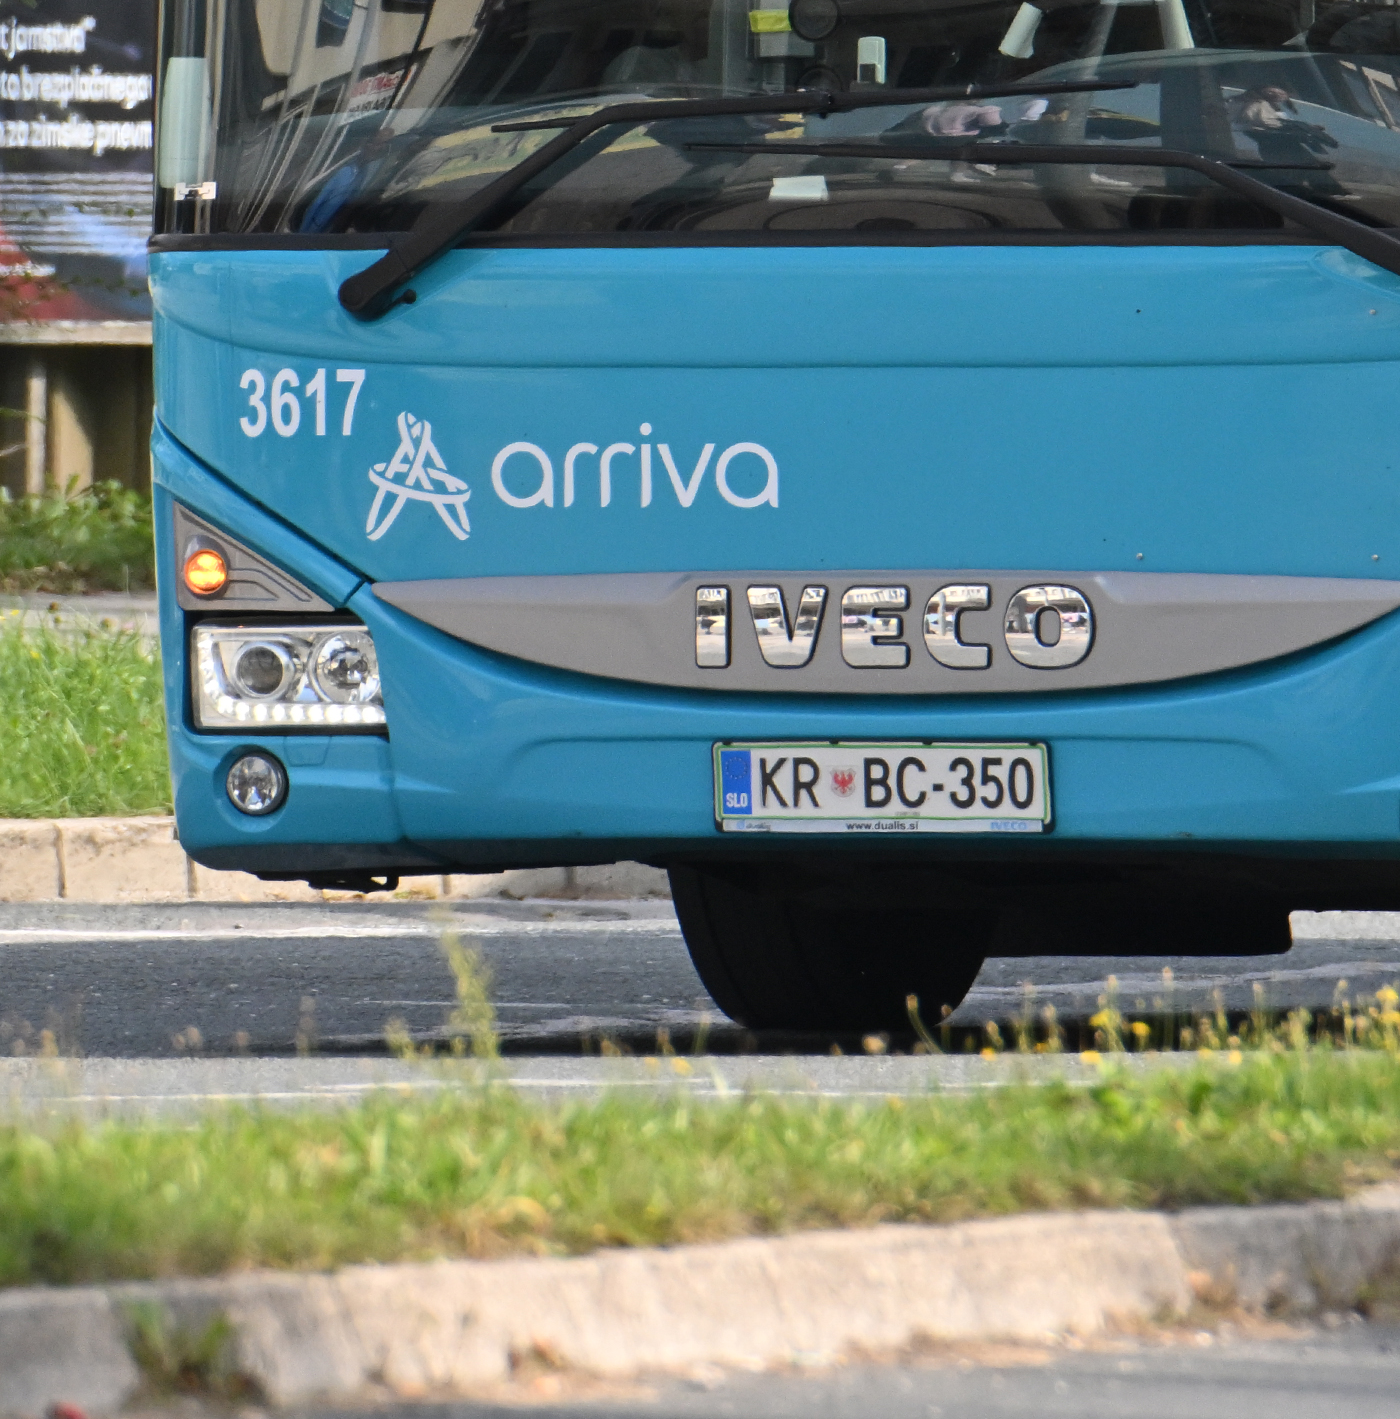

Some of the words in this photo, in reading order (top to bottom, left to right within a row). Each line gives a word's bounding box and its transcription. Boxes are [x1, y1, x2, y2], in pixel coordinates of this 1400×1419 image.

[6, 121, 30, 148] za
[30, 113, 95, 148] zimske
[239, 367, 366, 437] 3617
[490, 422, 780, 509] arriva
[693, 582, 1096, 670] IVECO
[726, 791, 748, 807] SLO
[759, 756, 821, 809] KR
[863, 755, 1036, 810] BC-350
[845, 819, 920, 831] www.dualis.si
[990, 821, 1028, 831] IVECO
